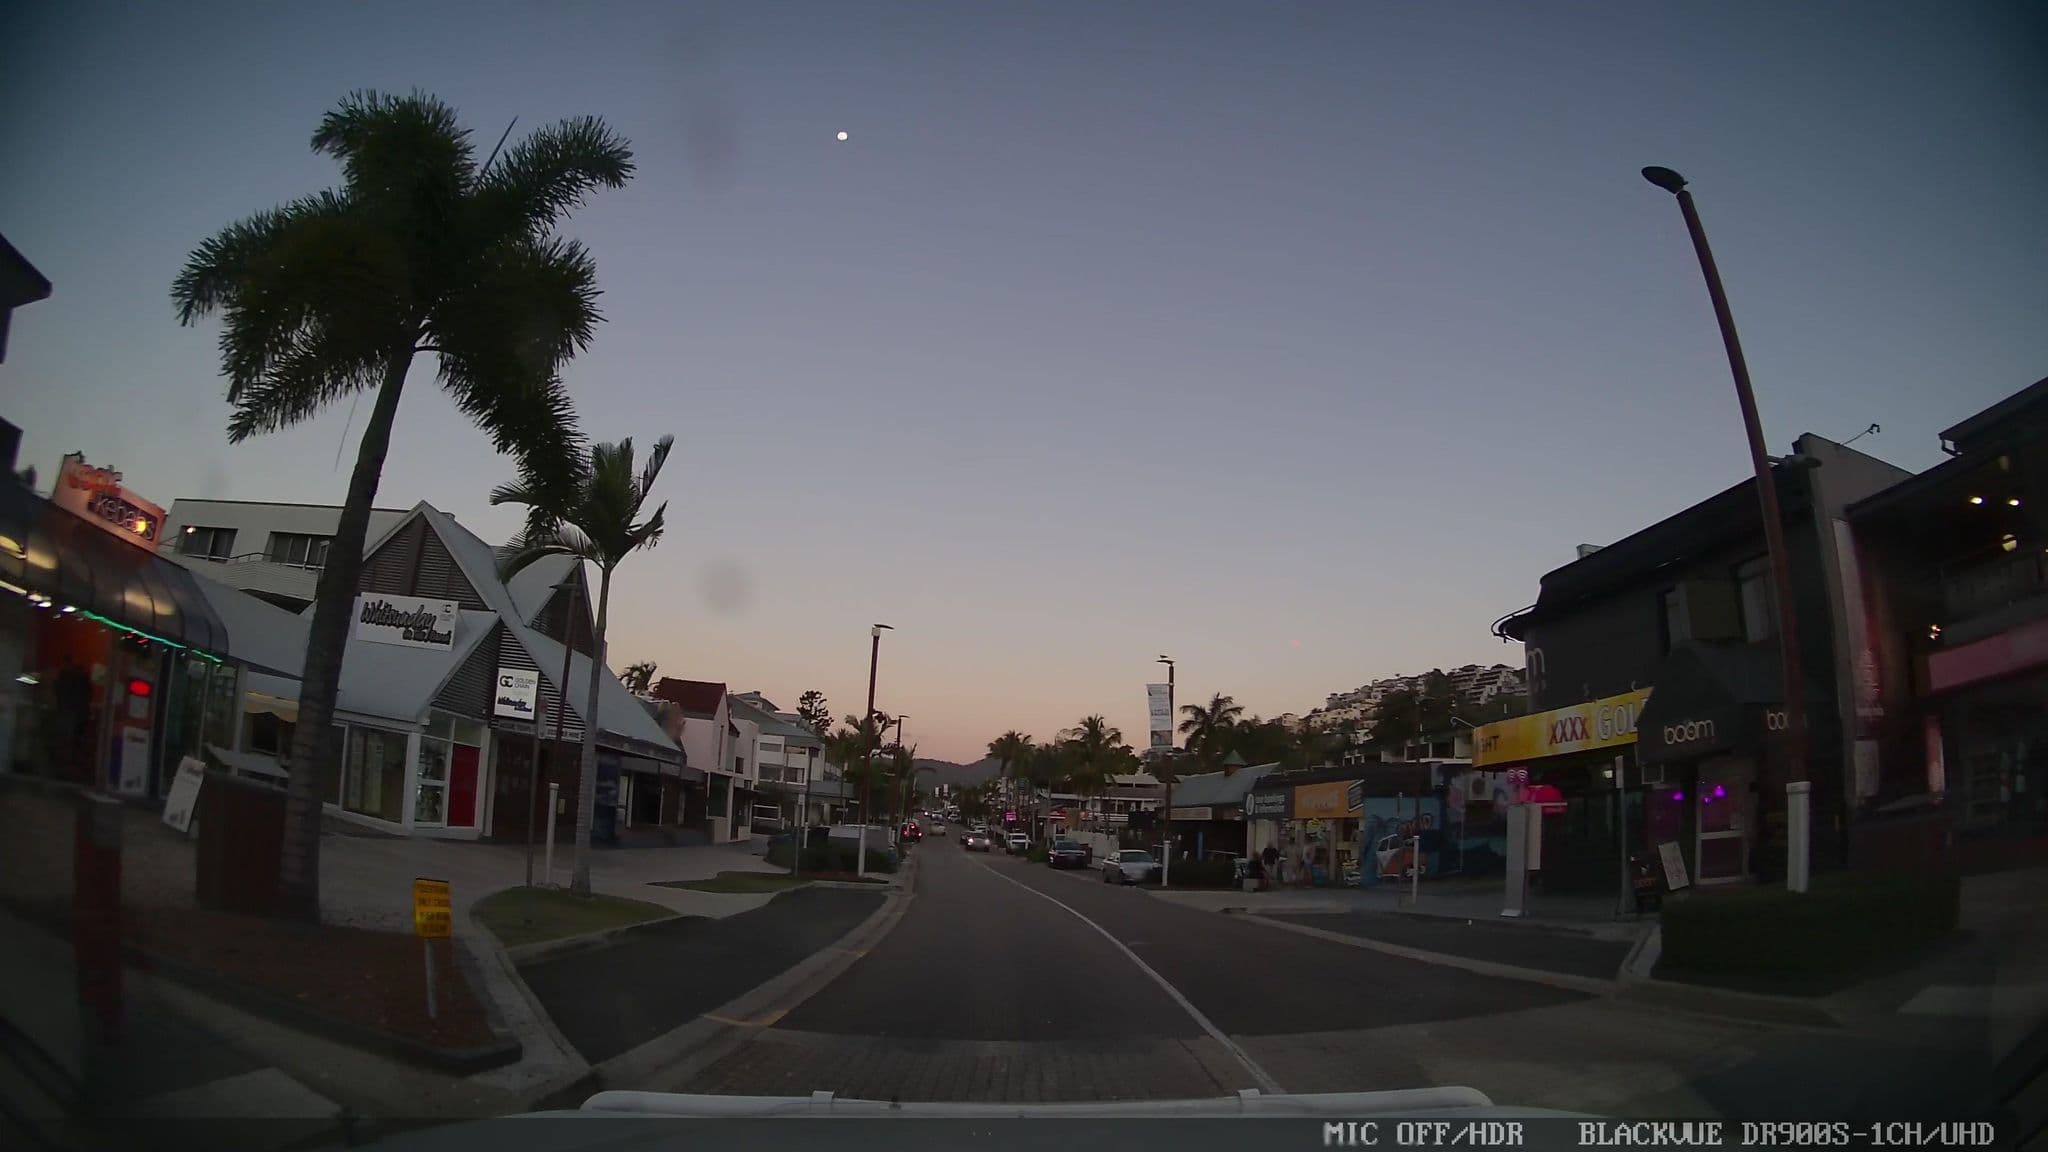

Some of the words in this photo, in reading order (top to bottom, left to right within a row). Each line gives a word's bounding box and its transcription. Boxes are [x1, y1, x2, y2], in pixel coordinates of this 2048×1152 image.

[360, 600, 437, 639] Whitsunday
[1550, 716, 1591, 746] XXXX
[1596, 700, 1642, 742] GOL
